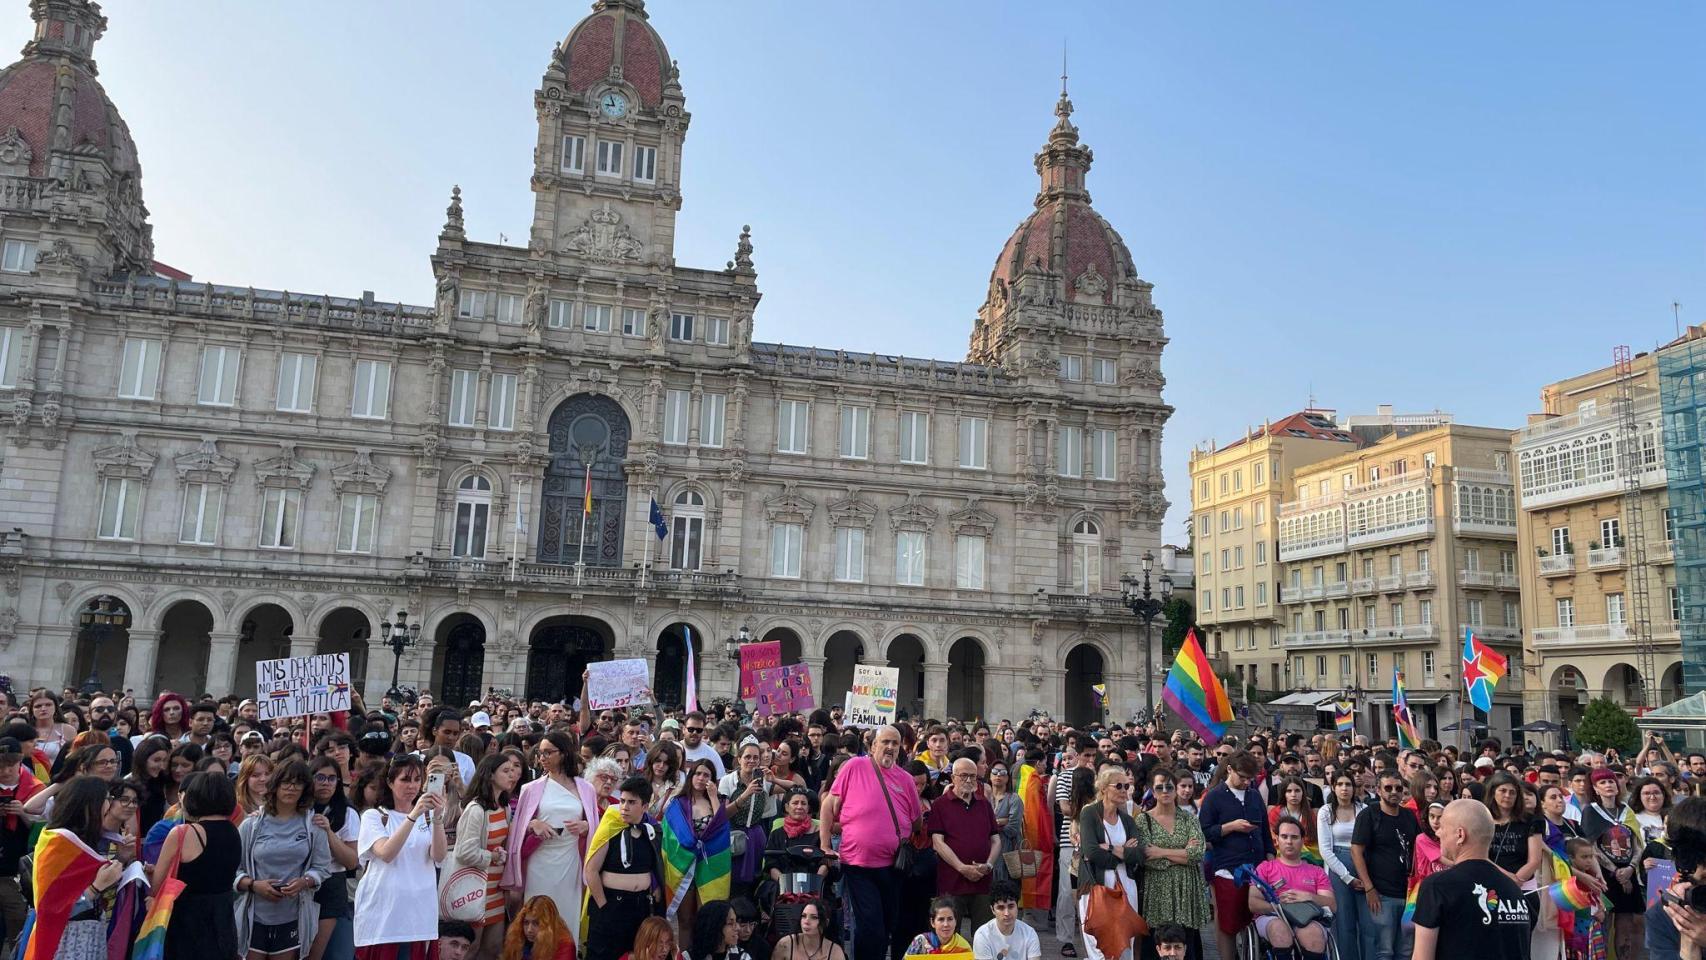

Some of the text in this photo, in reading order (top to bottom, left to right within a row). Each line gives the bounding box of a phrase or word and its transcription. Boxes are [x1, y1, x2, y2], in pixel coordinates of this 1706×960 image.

[262, 654, 345, 681] MIS DERECHOS
[258, 674, 344, 694] NO ENTRAN EN
[290, 688, 309, 698] TU
[258, 698, 289, 719] PUTA
[852, 714, 887, 725] FAMILIA
[451, 889, 484, 910] KENZO
[1498, 899, 1529, 913] ALAS
